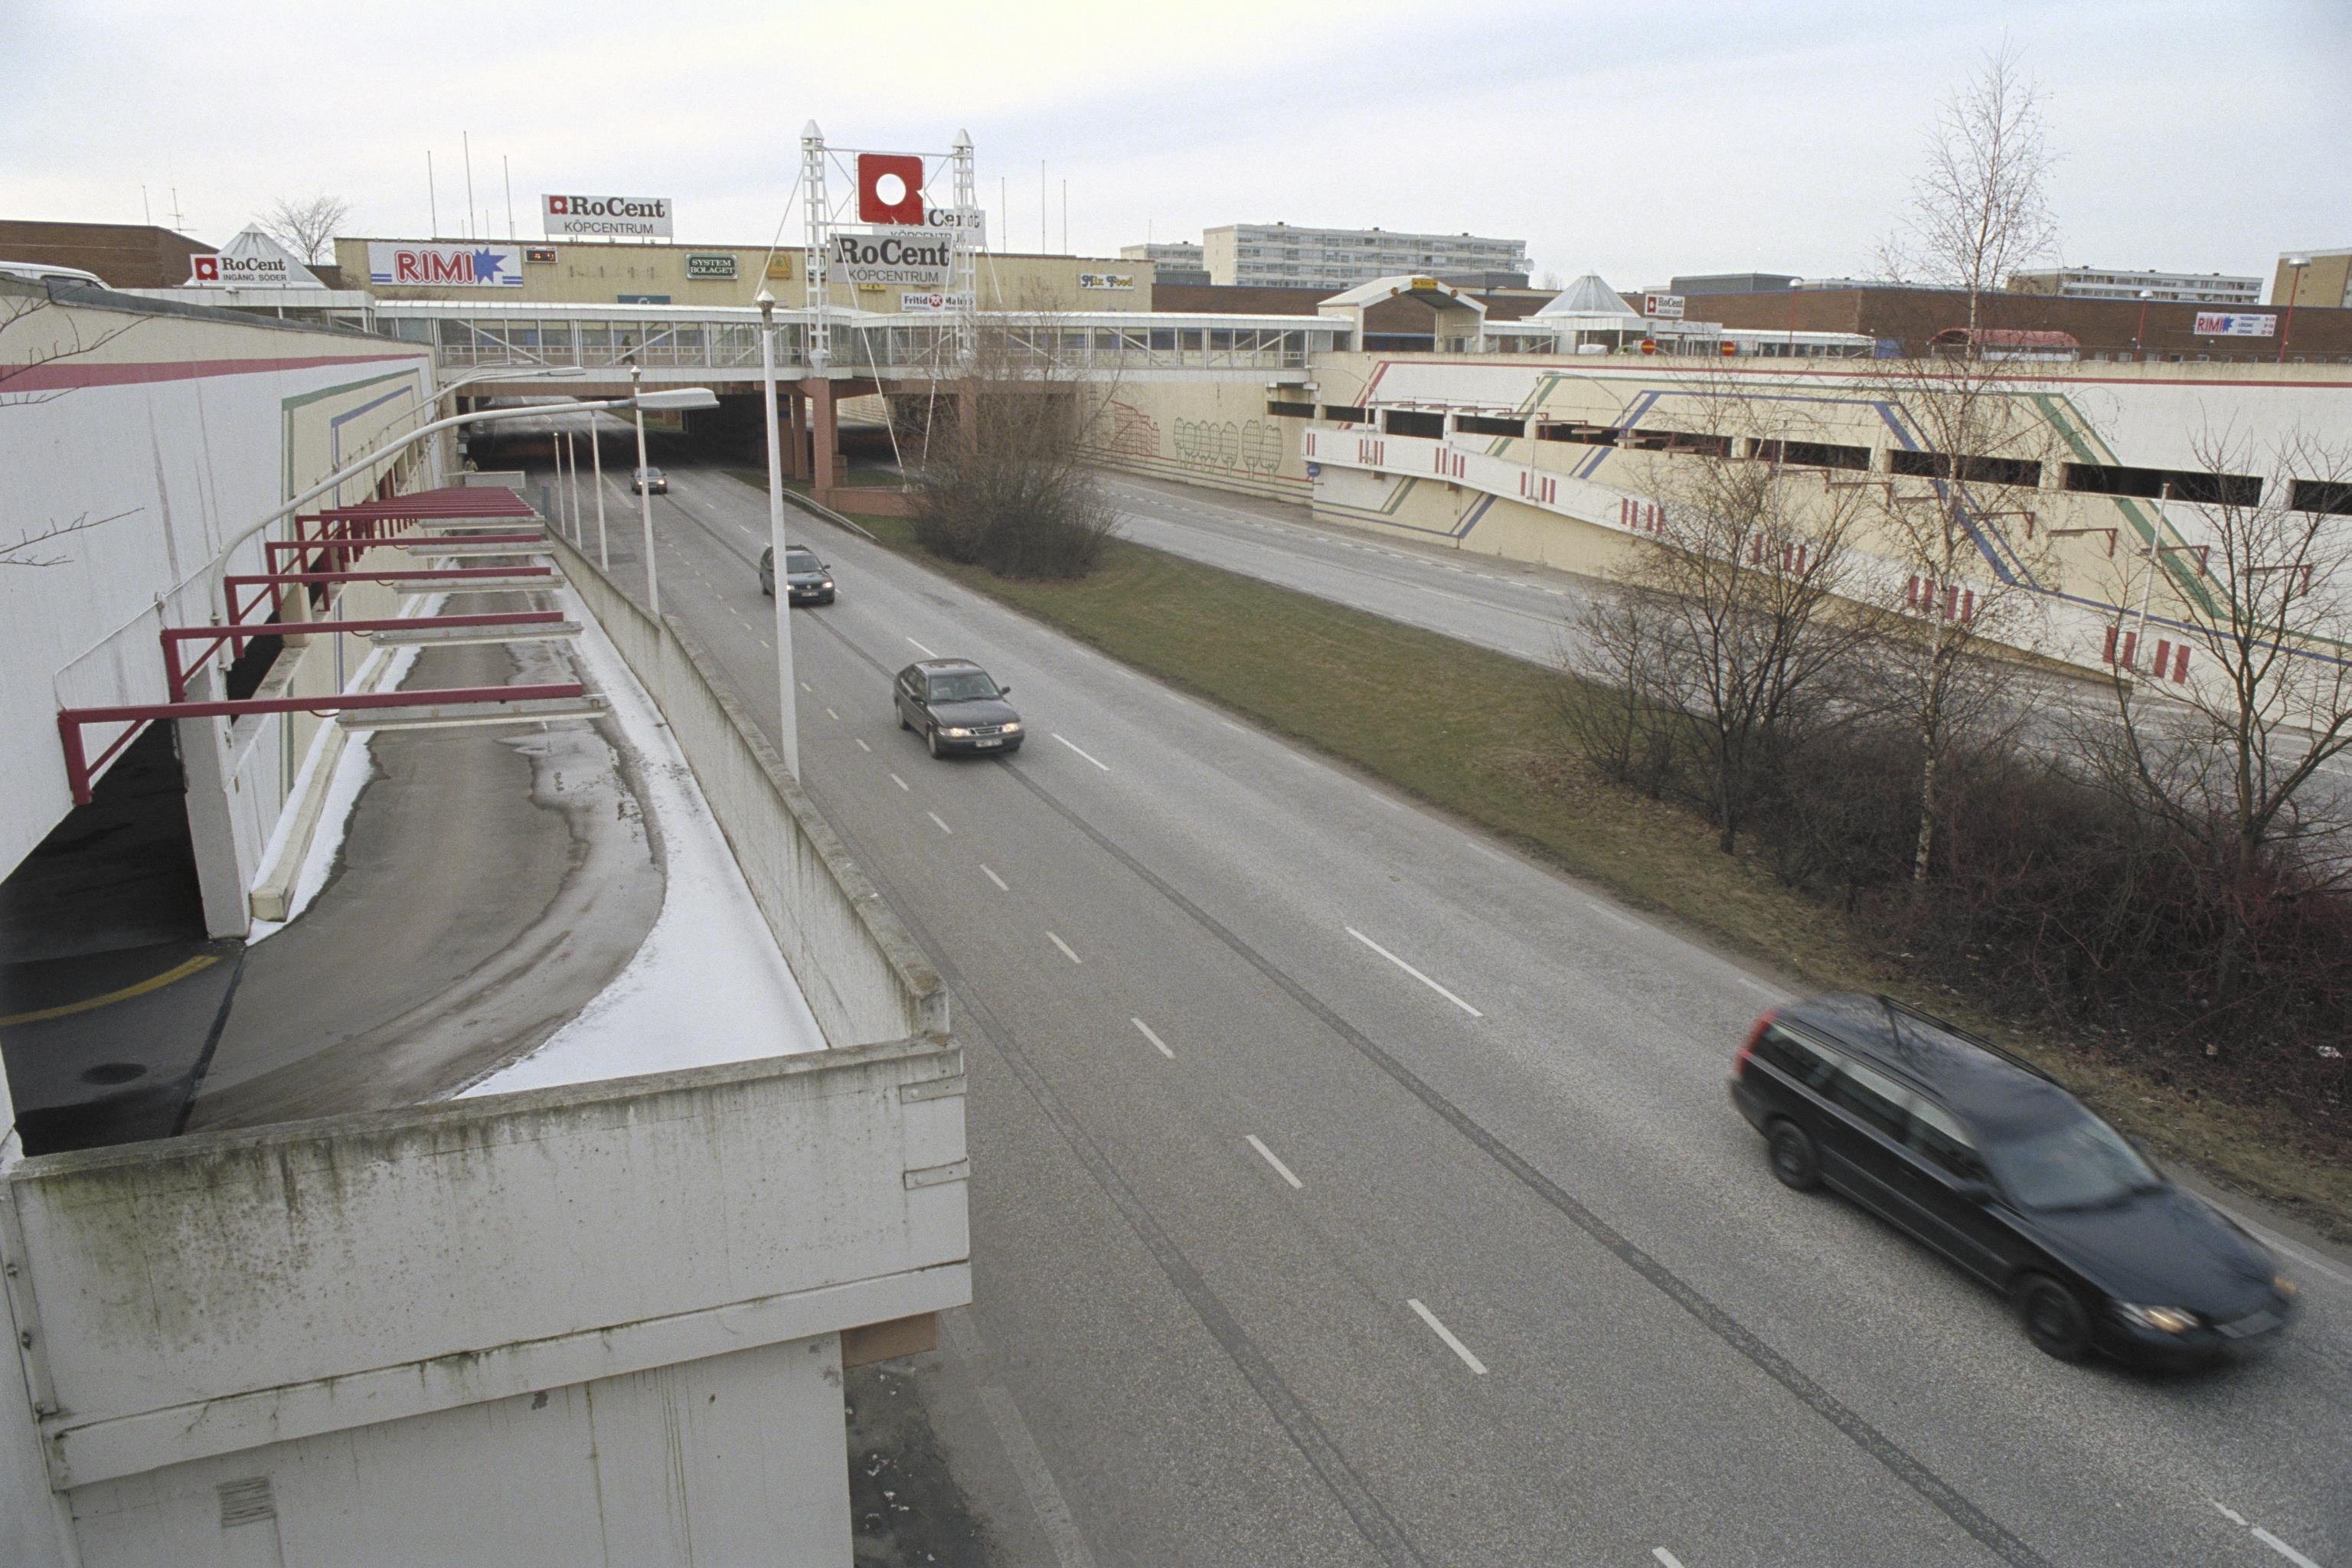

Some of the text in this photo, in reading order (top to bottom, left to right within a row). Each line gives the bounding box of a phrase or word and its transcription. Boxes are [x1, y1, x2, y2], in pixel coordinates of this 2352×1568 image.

[570, 196, 665, 218] RoCent
[564, 220, 653, 234] KÖPCENTRUM
[835, 238, 949, 266] RoCent
[220, 257, 286, 271] RoCent
[394, 250, 475, 283] RIMI
[223, 273, 255, 281] INGÅNG
[848, 267, 939, 283] KÖPCENTRUM
[904, 296, 928, 305] Fritid
[2197, 318, 2223, 332] RIMI
